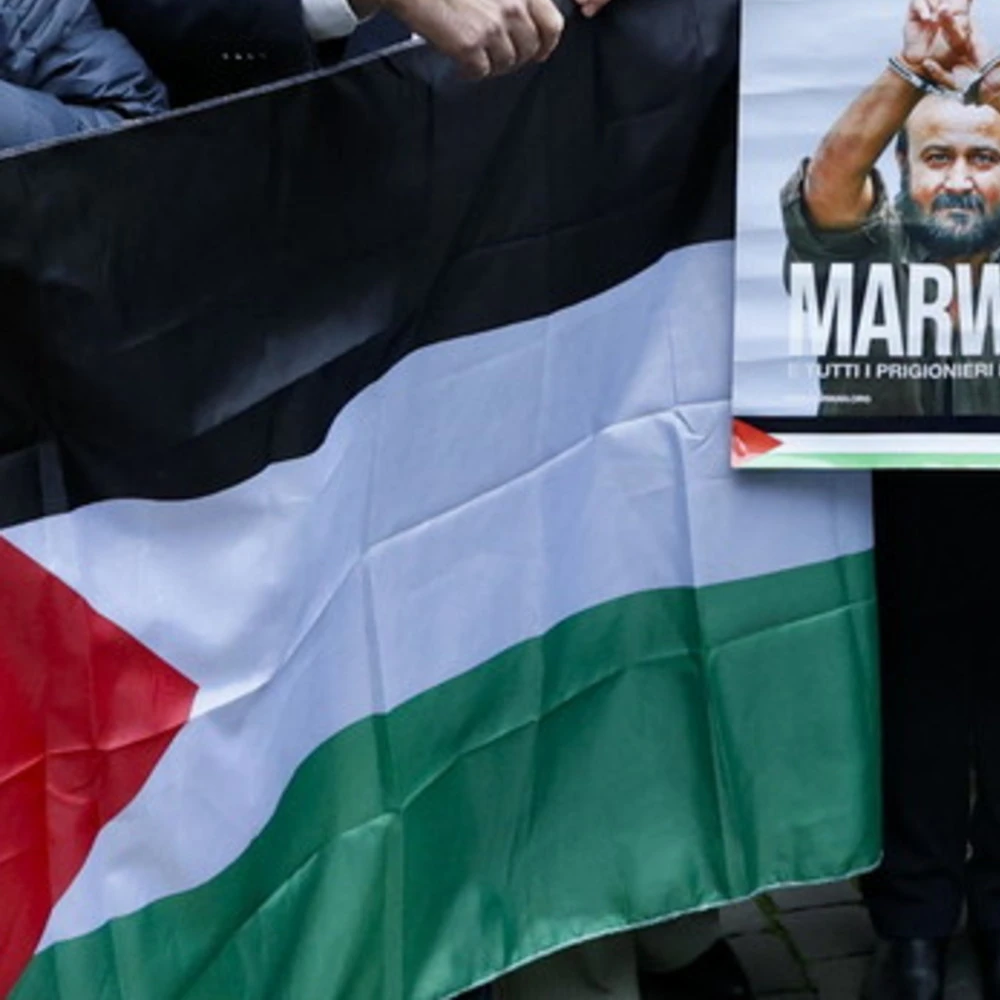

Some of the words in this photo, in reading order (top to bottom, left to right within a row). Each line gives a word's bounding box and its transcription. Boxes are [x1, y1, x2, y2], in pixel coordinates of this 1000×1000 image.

[806, 362, 861, 379] TUTTI
[865, 362, 872, 379] I
[876, 361, 994, 380] PRIGIONIERI
